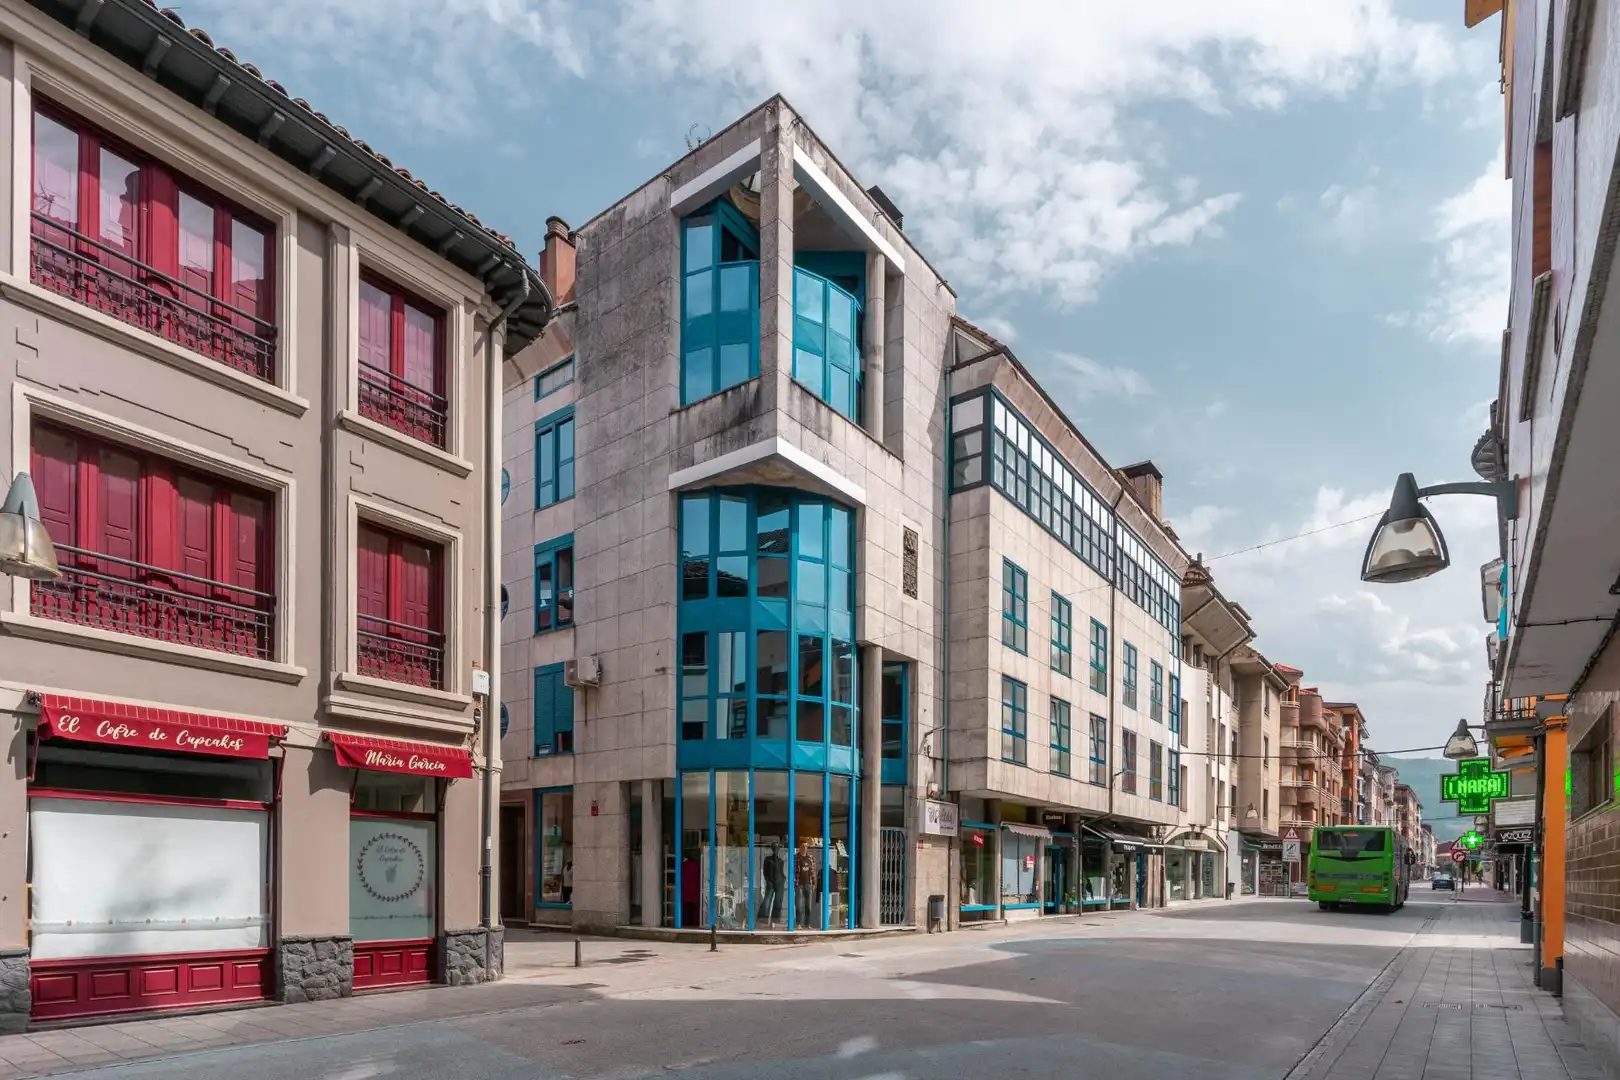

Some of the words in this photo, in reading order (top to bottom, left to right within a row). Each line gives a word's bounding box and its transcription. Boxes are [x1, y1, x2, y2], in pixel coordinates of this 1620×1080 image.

[57, 715, 80, 733] El
[97, 720, 138, 740] Cofre
[149, 727, 168, 741] de
[176, 730, 244, 751] Cupcakes
